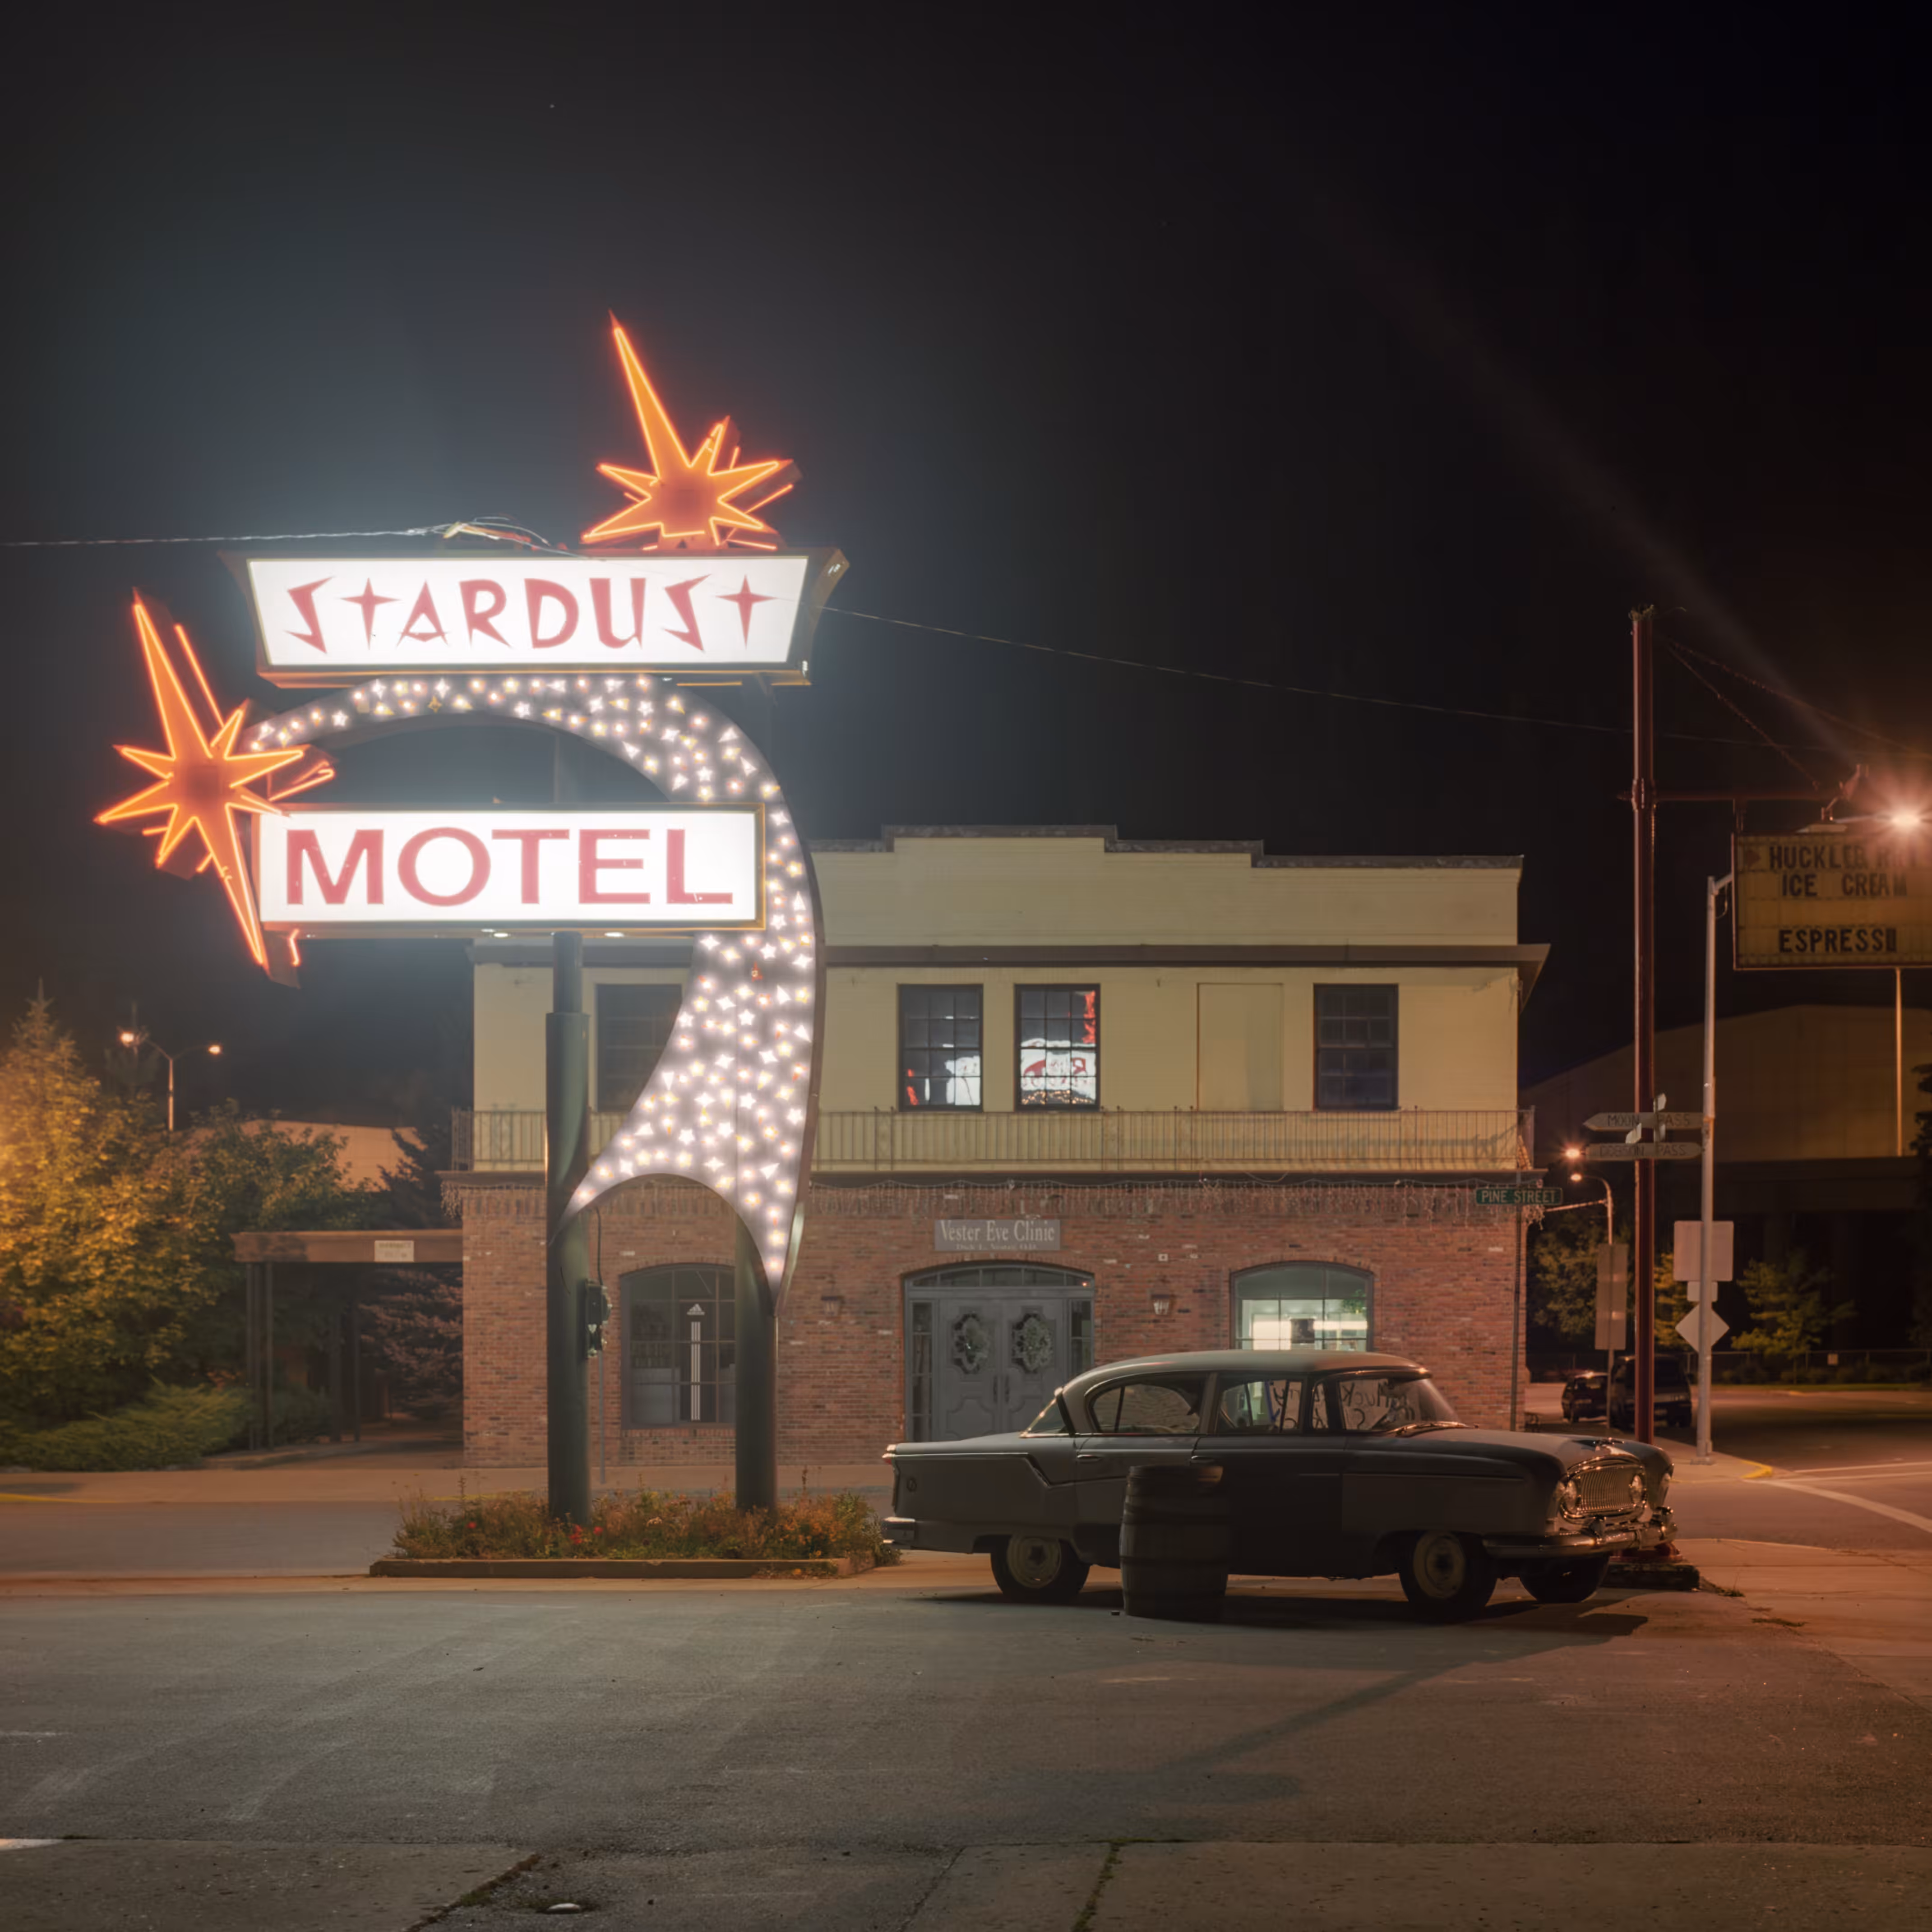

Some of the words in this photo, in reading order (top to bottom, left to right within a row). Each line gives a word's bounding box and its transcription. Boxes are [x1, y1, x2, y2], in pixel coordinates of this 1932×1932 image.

[284, 574, 777, 654] STARDUST
[286, 826, 734, 906] MOTEL
[1782, 874, 1818, 897] ICE
[1842, 873, 1907, 897] CREAM
[1607, 1114, 1640, 1127] MOON
[1658, 1114, 1690, 1126] PASS
[1658, 1144, 1687, 1156] PASS
[1481, 1190, 1507, 1203] PINE
[1514, 1190, 1556, 1203] STREET
[940, 1219, 981, 1242] Vester
[1013, 1219, 1055, 1242] Clinic
